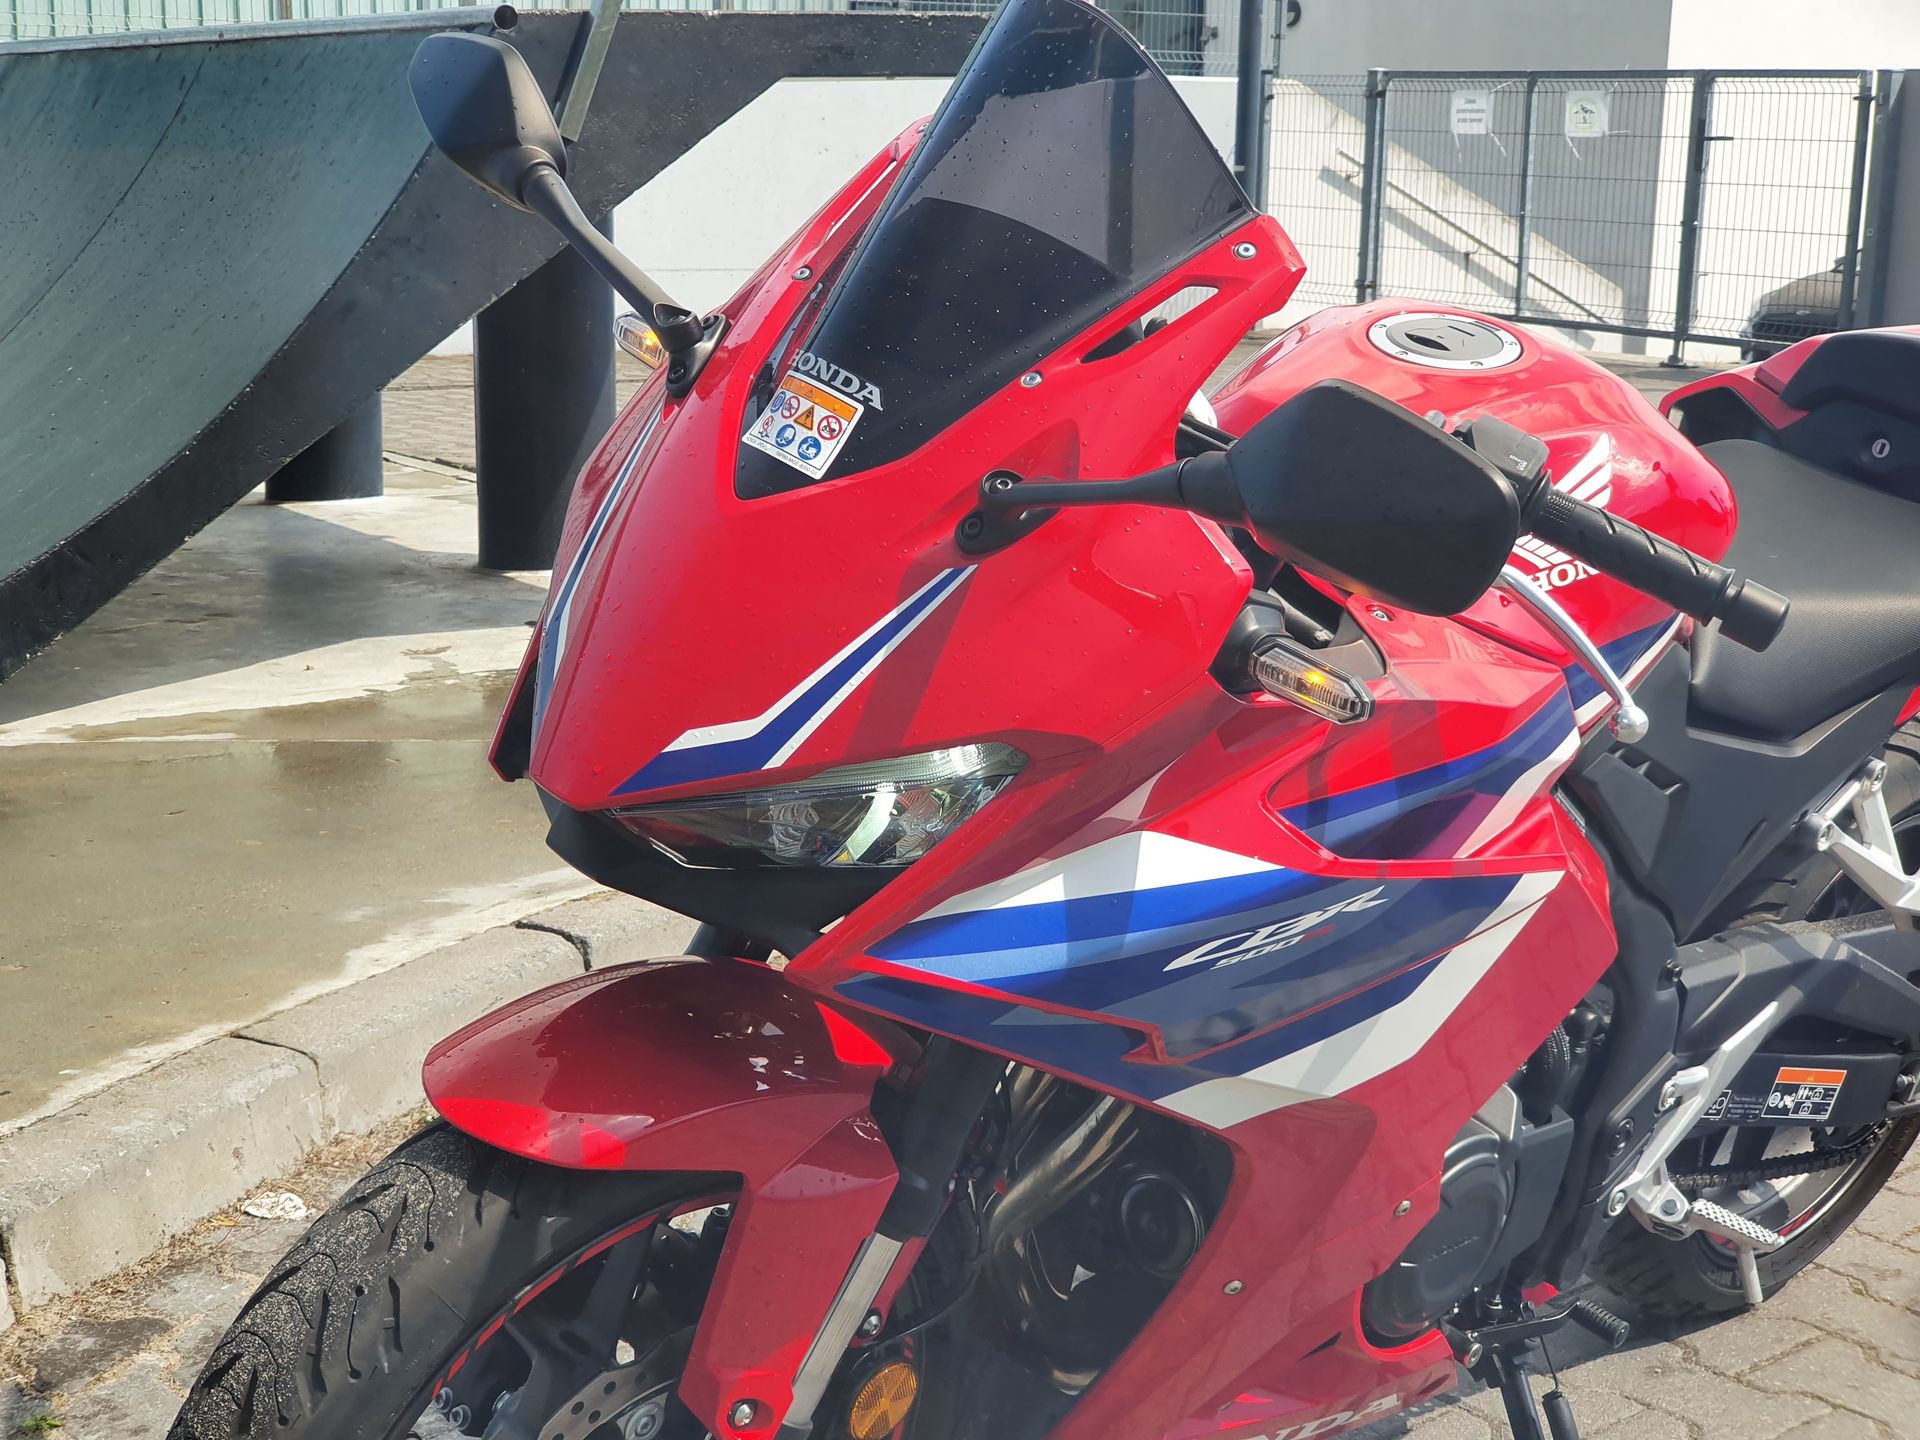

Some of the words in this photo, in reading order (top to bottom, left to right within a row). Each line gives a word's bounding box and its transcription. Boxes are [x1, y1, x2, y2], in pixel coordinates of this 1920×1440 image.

[787, 349, 884, 411] HONDA
[1527, 560, 1601, 592] HON
[1162, 885, 1389, 972] CBR
[1243, 1393, 1401, 1440] NDA
